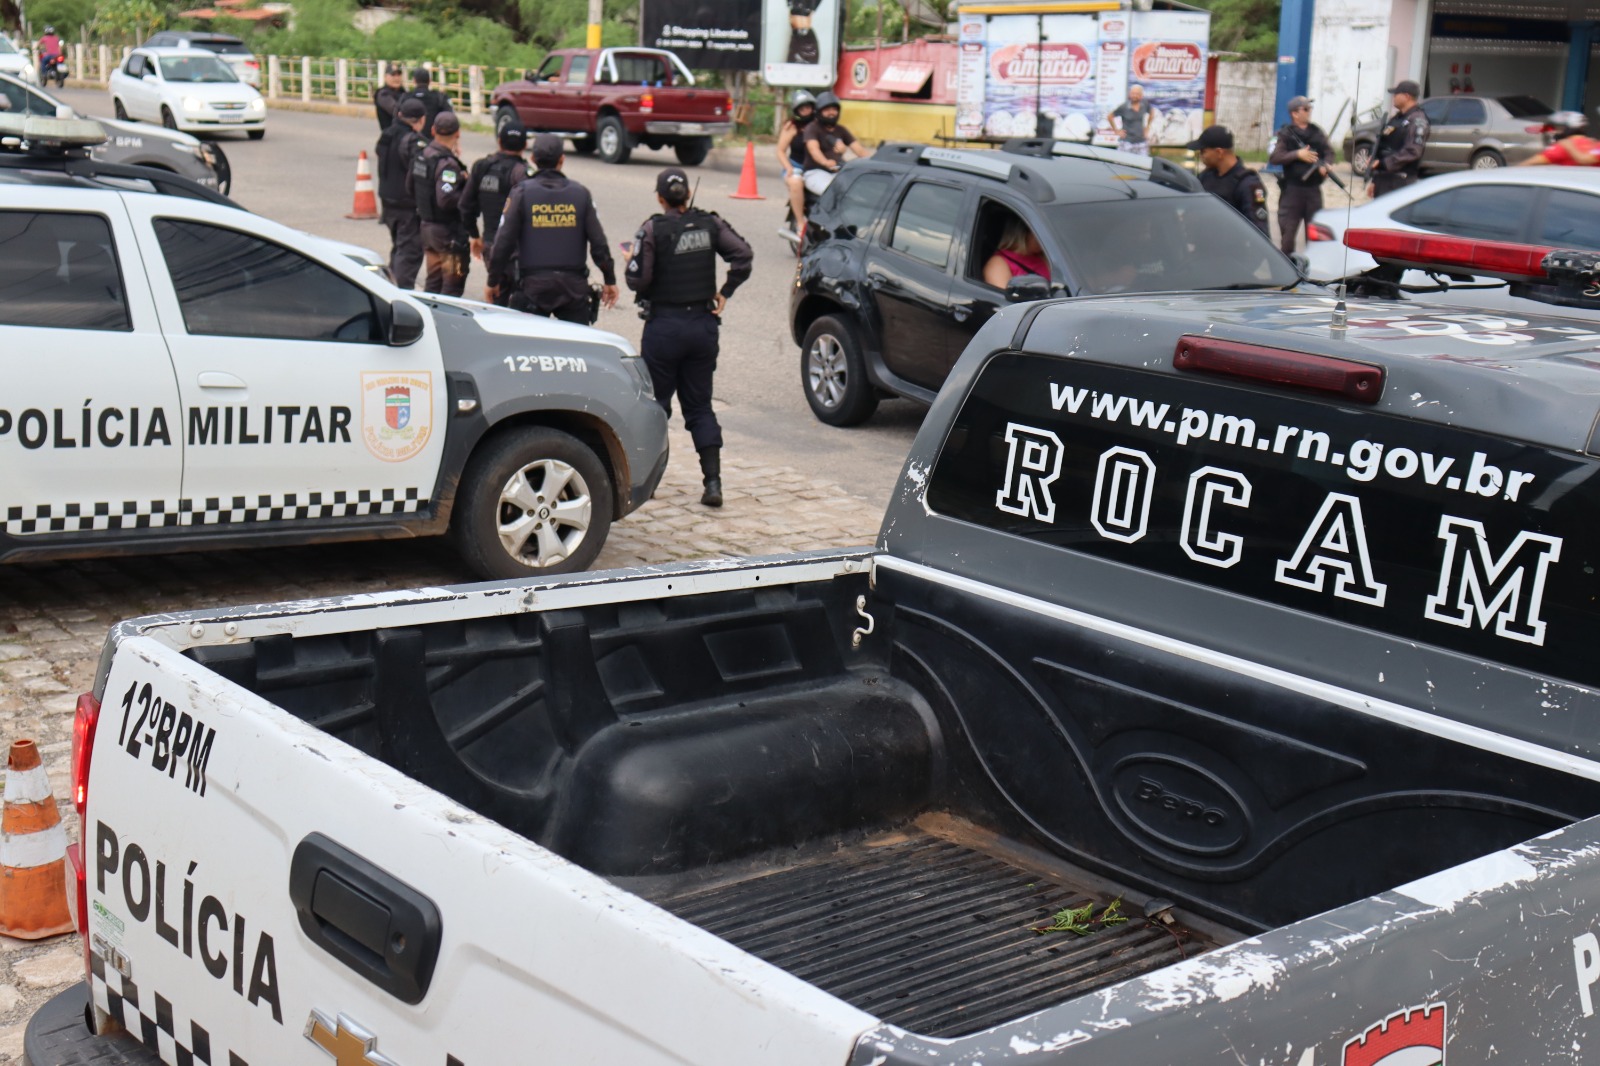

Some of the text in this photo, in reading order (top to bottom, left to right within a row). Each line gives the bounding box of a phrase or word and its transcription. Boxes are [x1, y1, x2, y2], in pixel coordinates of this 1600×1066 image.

[671, 26, 748, 40] Shopping Liberdade
[532, 203, 576, 214] POLICIA
[532, 214, 576, 223] MILITAR
[188, 405, 352, 446] MILITAR
[1049, 382, 1534, 502] www.pm.rn.gov.br
[996, 422, 1563, 646] ROCAM
[96, 820, 283, 1026] POLÍCIA
